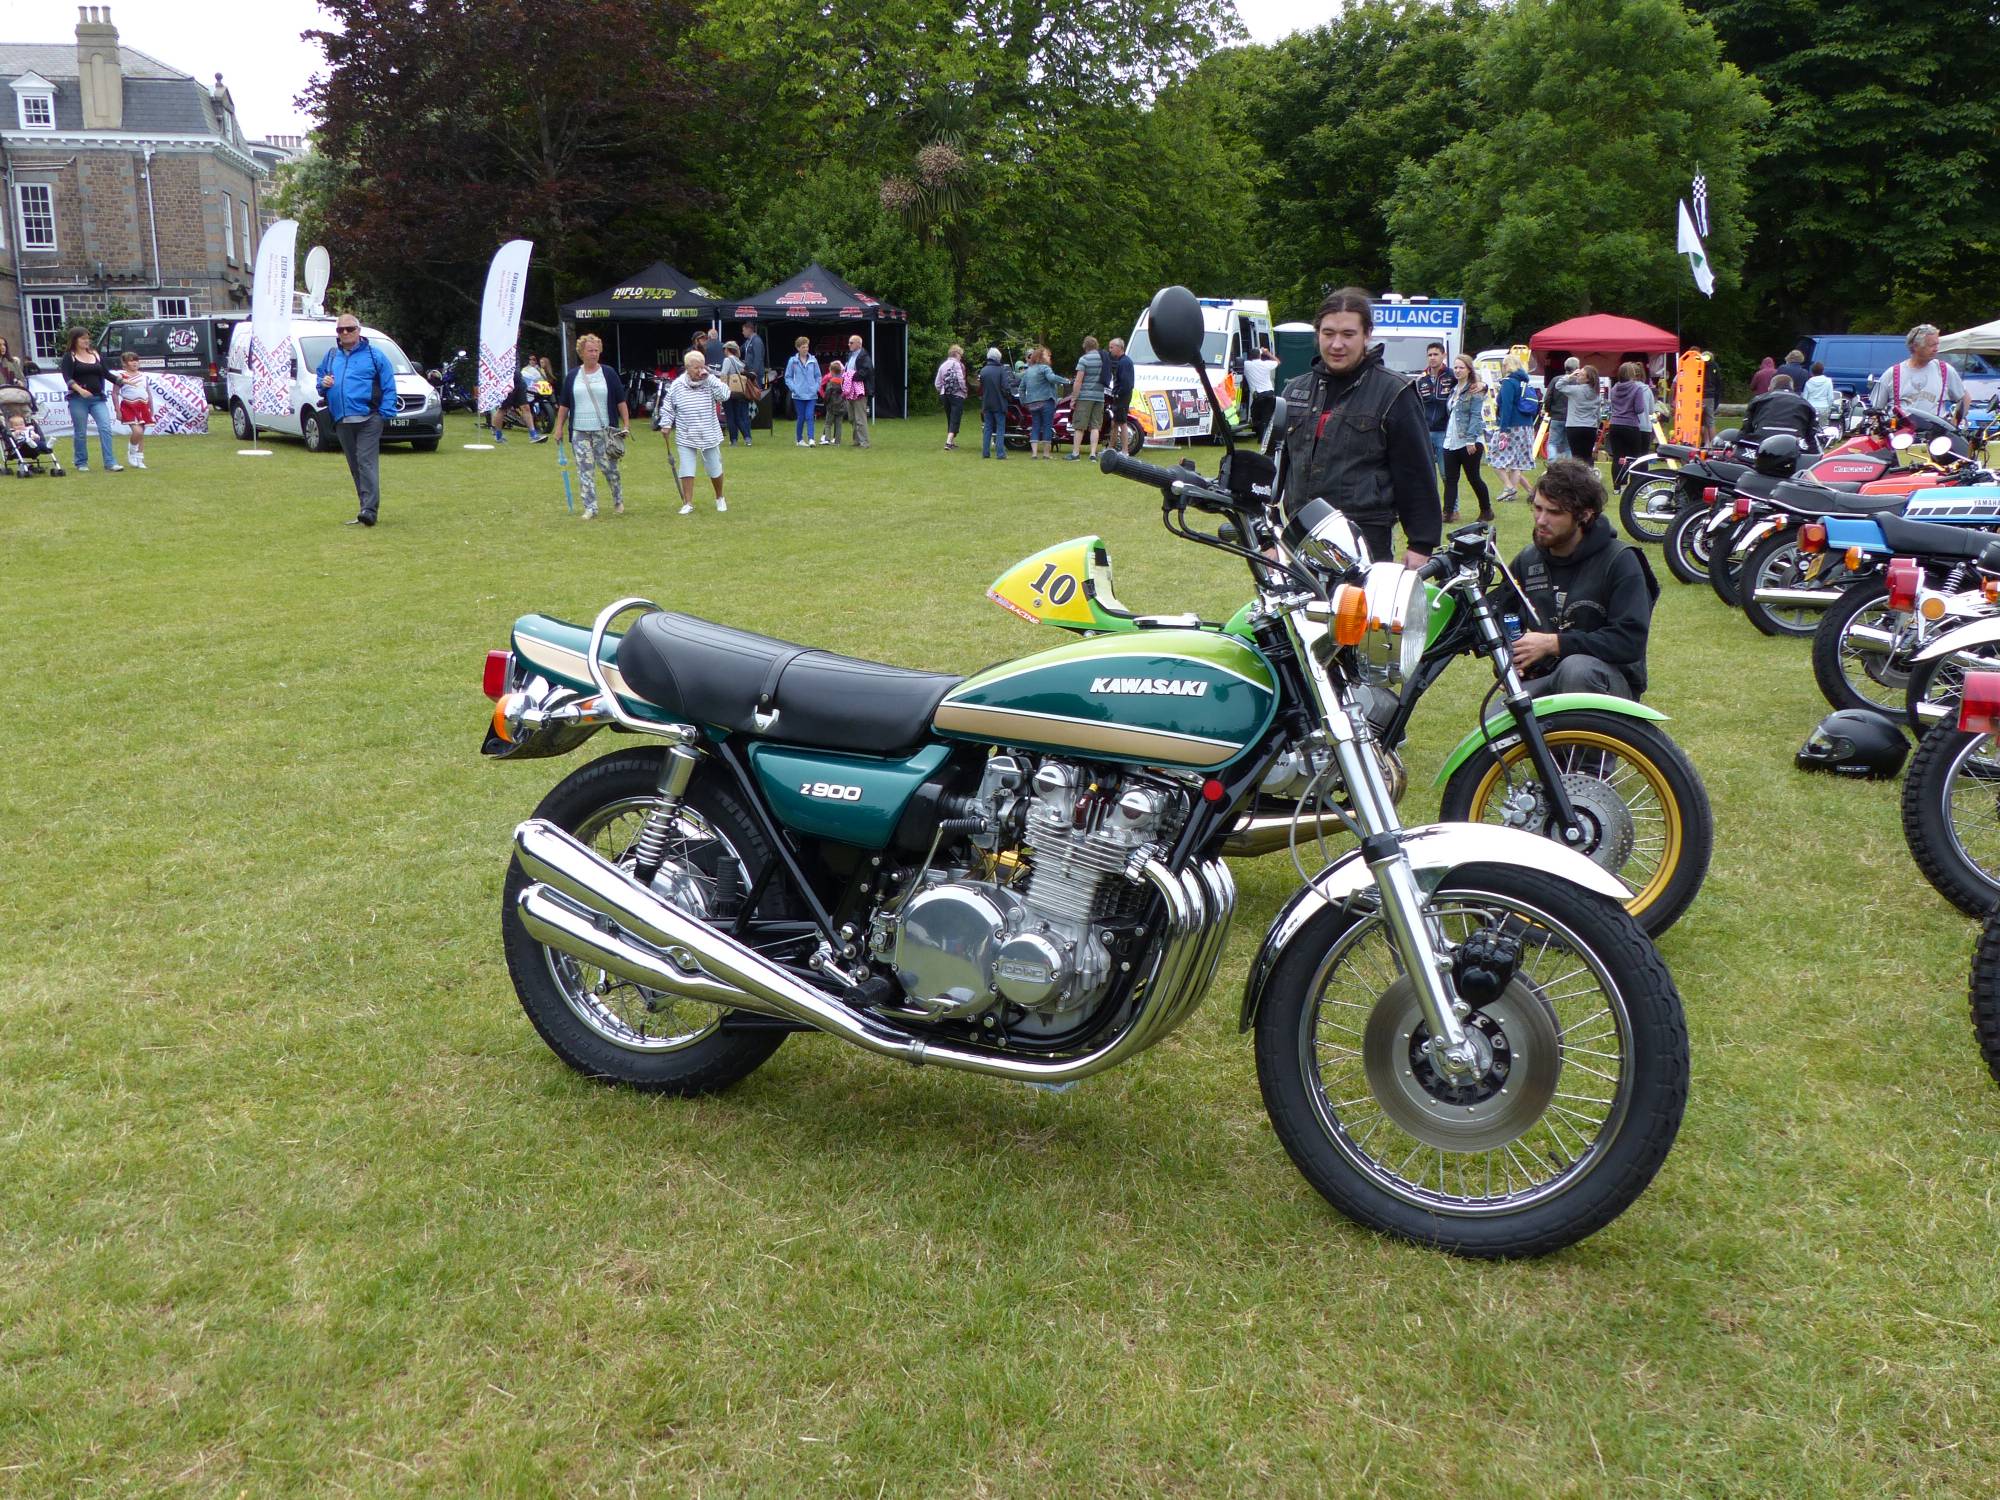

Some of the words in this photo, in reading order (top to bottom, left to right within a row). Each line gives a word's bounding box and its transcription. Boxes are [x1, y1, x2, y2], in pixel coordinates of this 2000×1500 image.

[1373, 310, 1454, 324] BULANCE
[148, 378, 184, 412] VIOUR'S
[1030, 563, 1077, 606] 10
[1008, 604, 1040, 624] RACING
[1090, 678, 1208, 697] KAWASAKI
